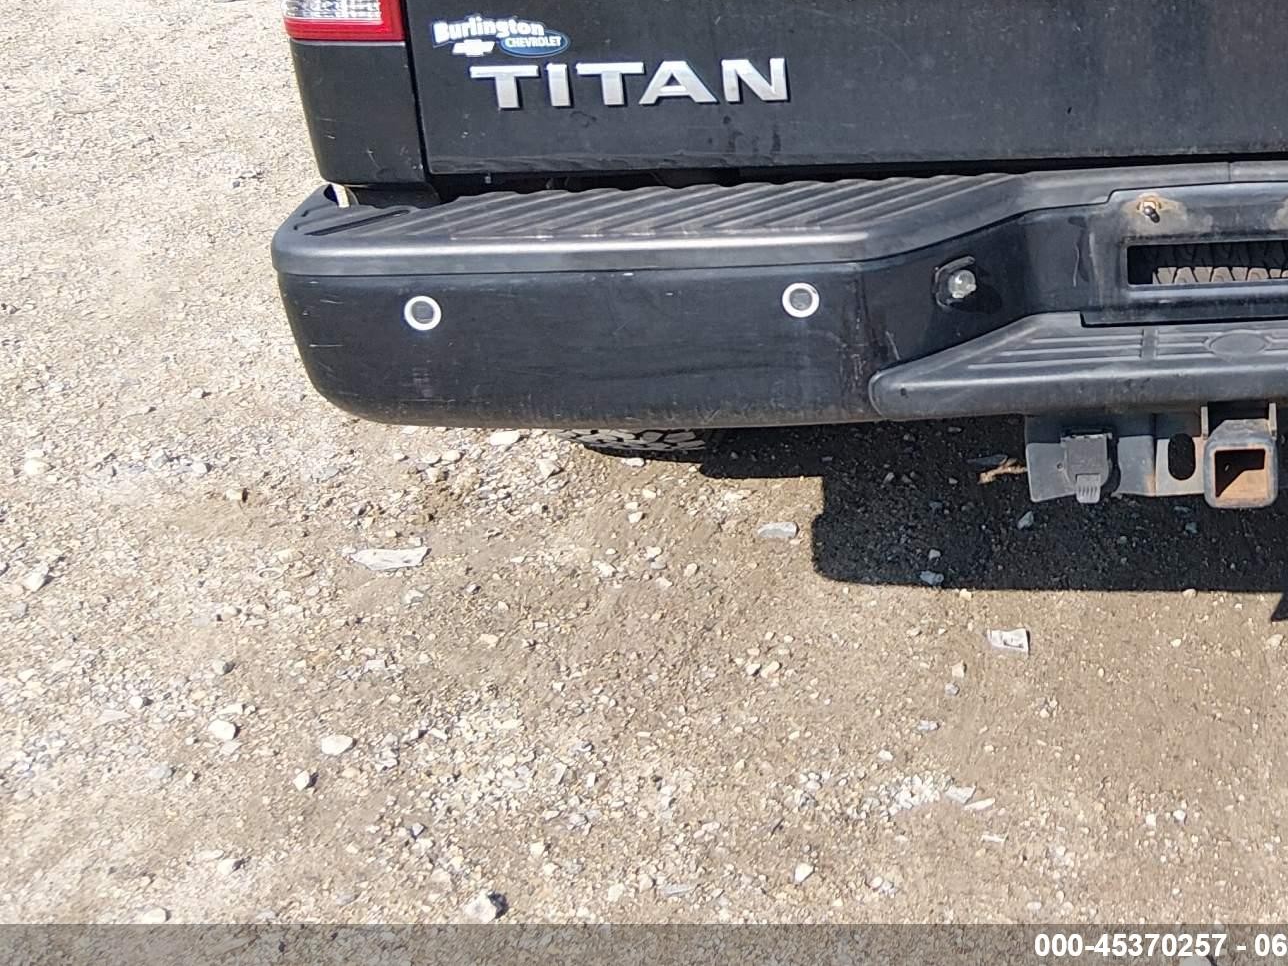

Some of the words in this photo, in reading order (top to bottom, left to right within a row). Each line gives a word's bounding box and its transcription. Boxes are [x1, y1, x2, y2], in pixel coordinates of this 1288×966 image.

[433, 15, 545, 44] Burlington
[504, 35, 562, 48] CHEVROLET
[469, 57, 789, 110] TITAN
